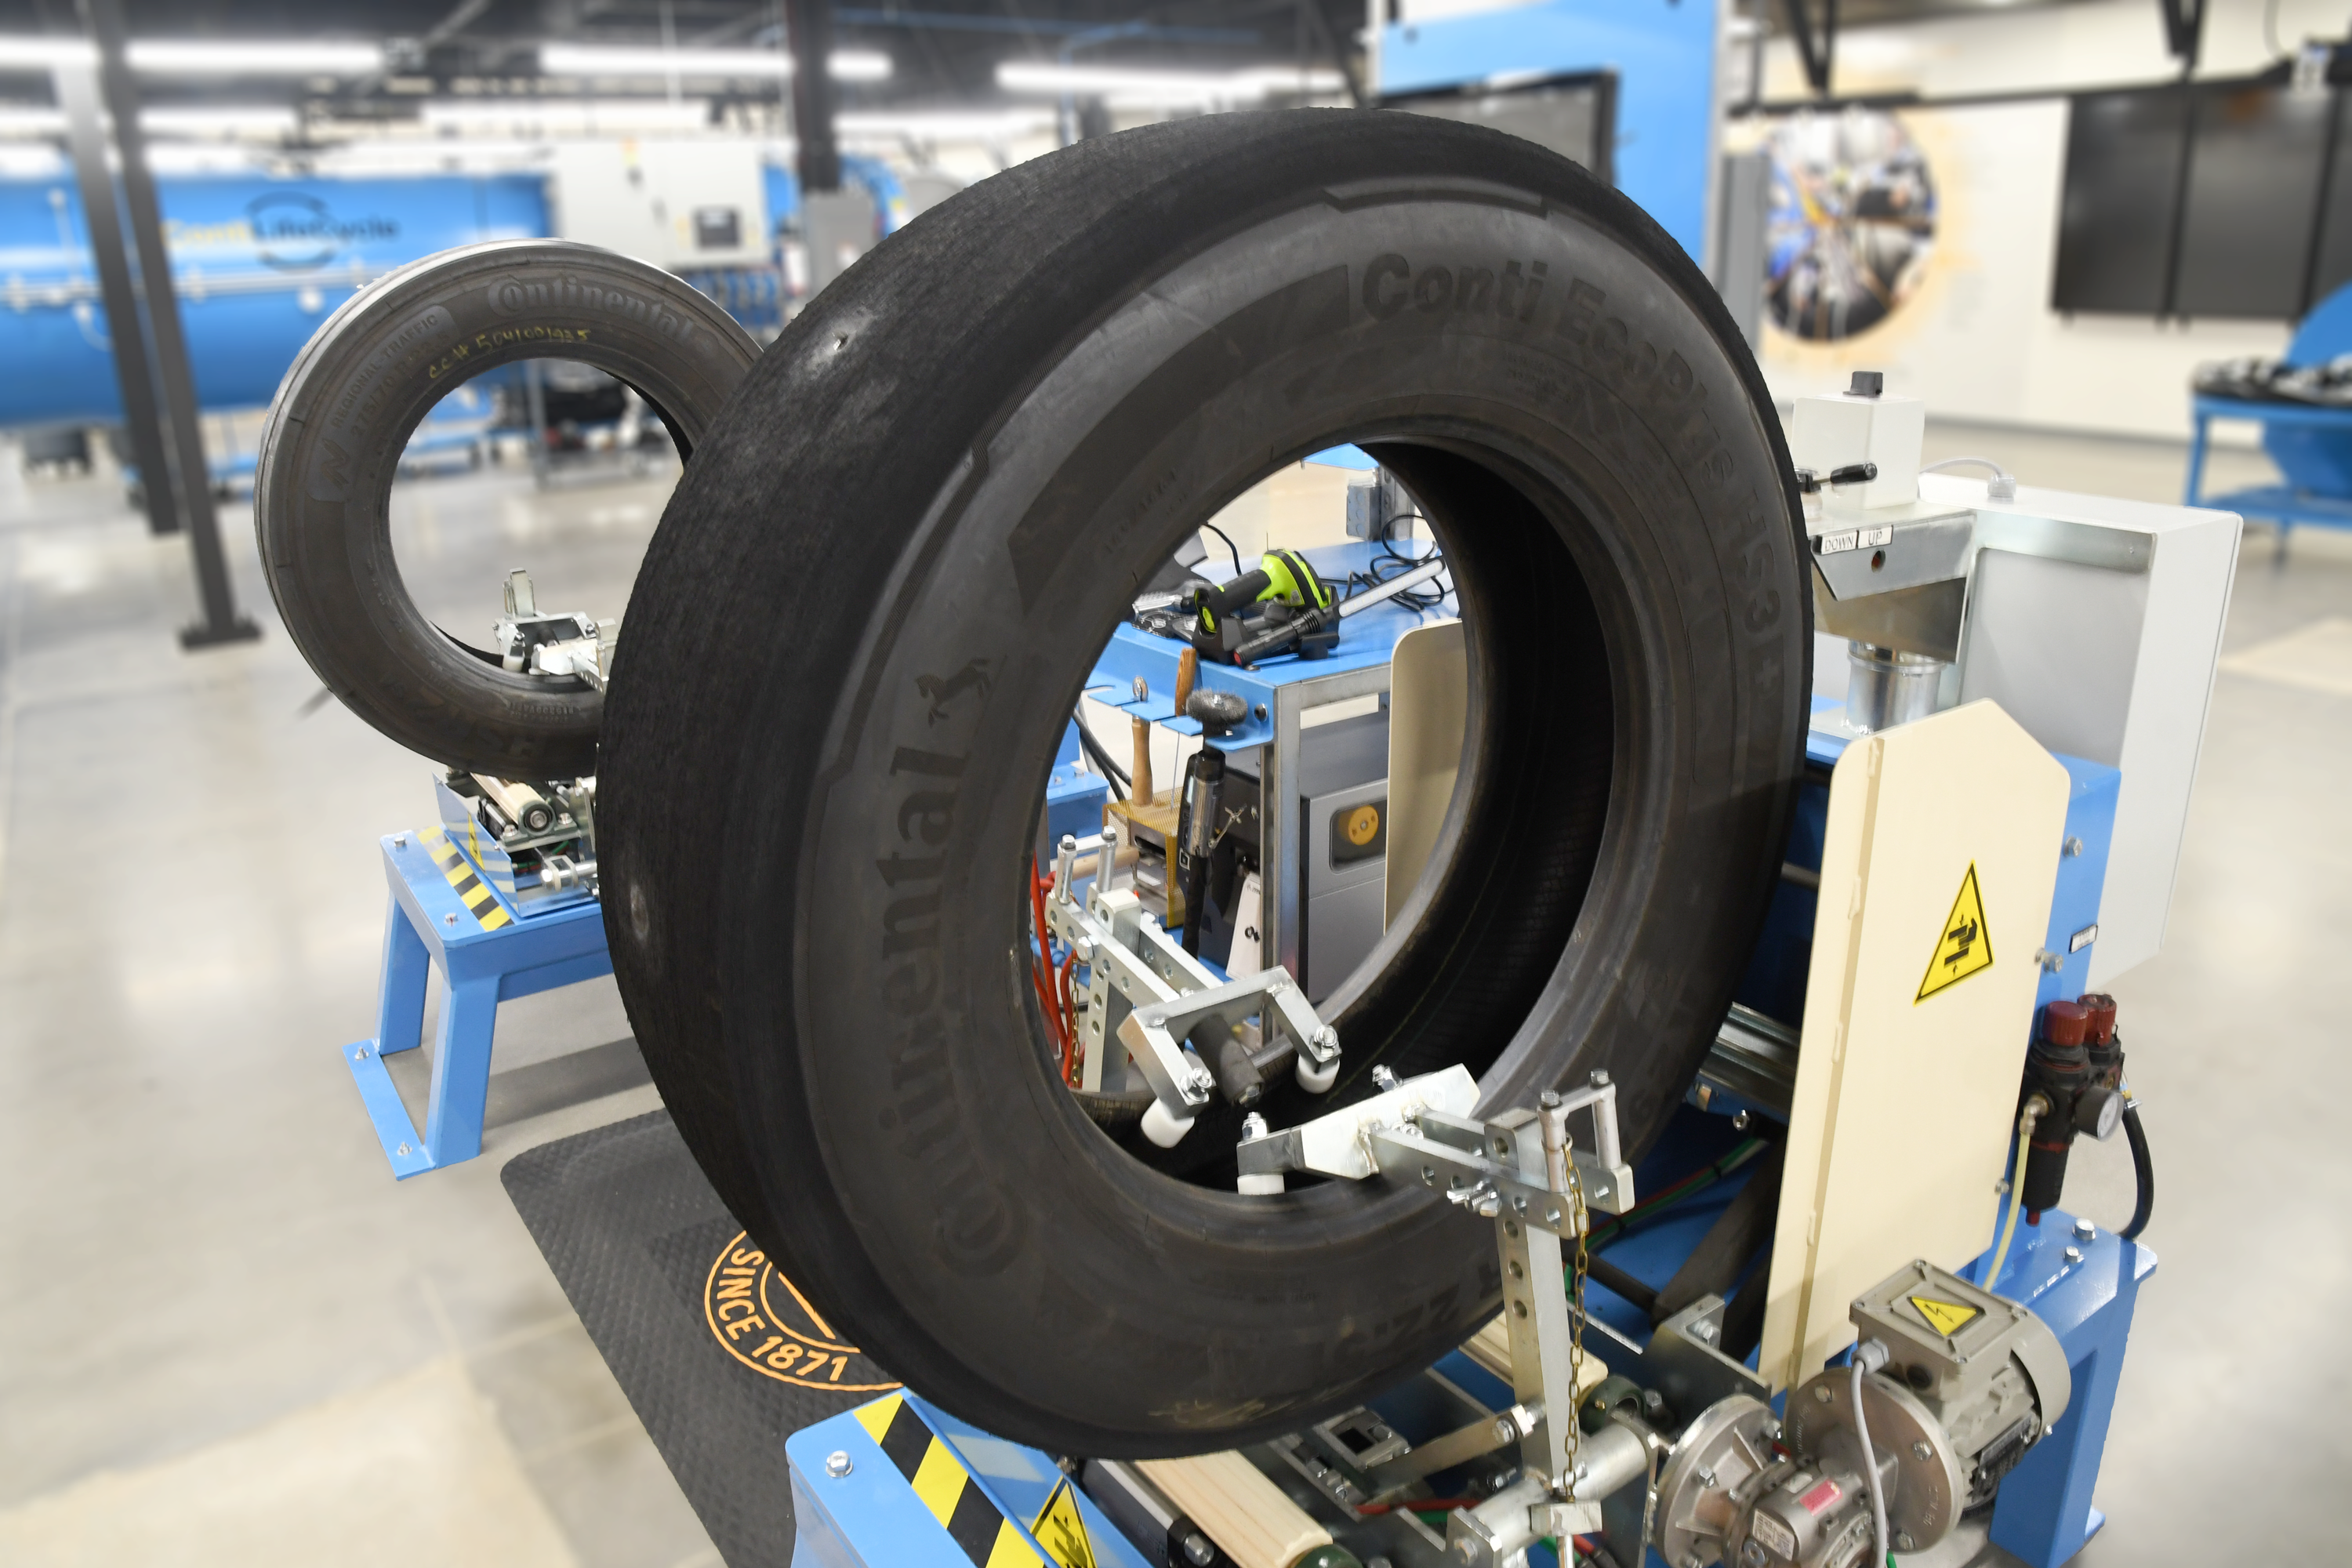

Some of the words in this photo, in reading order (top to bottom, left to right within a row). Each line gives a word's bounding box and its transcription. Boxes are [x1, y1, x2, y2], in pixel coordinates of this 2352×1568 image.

[488, 276, 693, 340] Continental
[1362, 252, 1548, 323] Conti
[1824, 535, 1854, 552] DOWN
[1867, 528, 1883, 546] UP
[717, 1248, 766, 1341] SINCE
[751, 1335, 848, 1381] 1871
